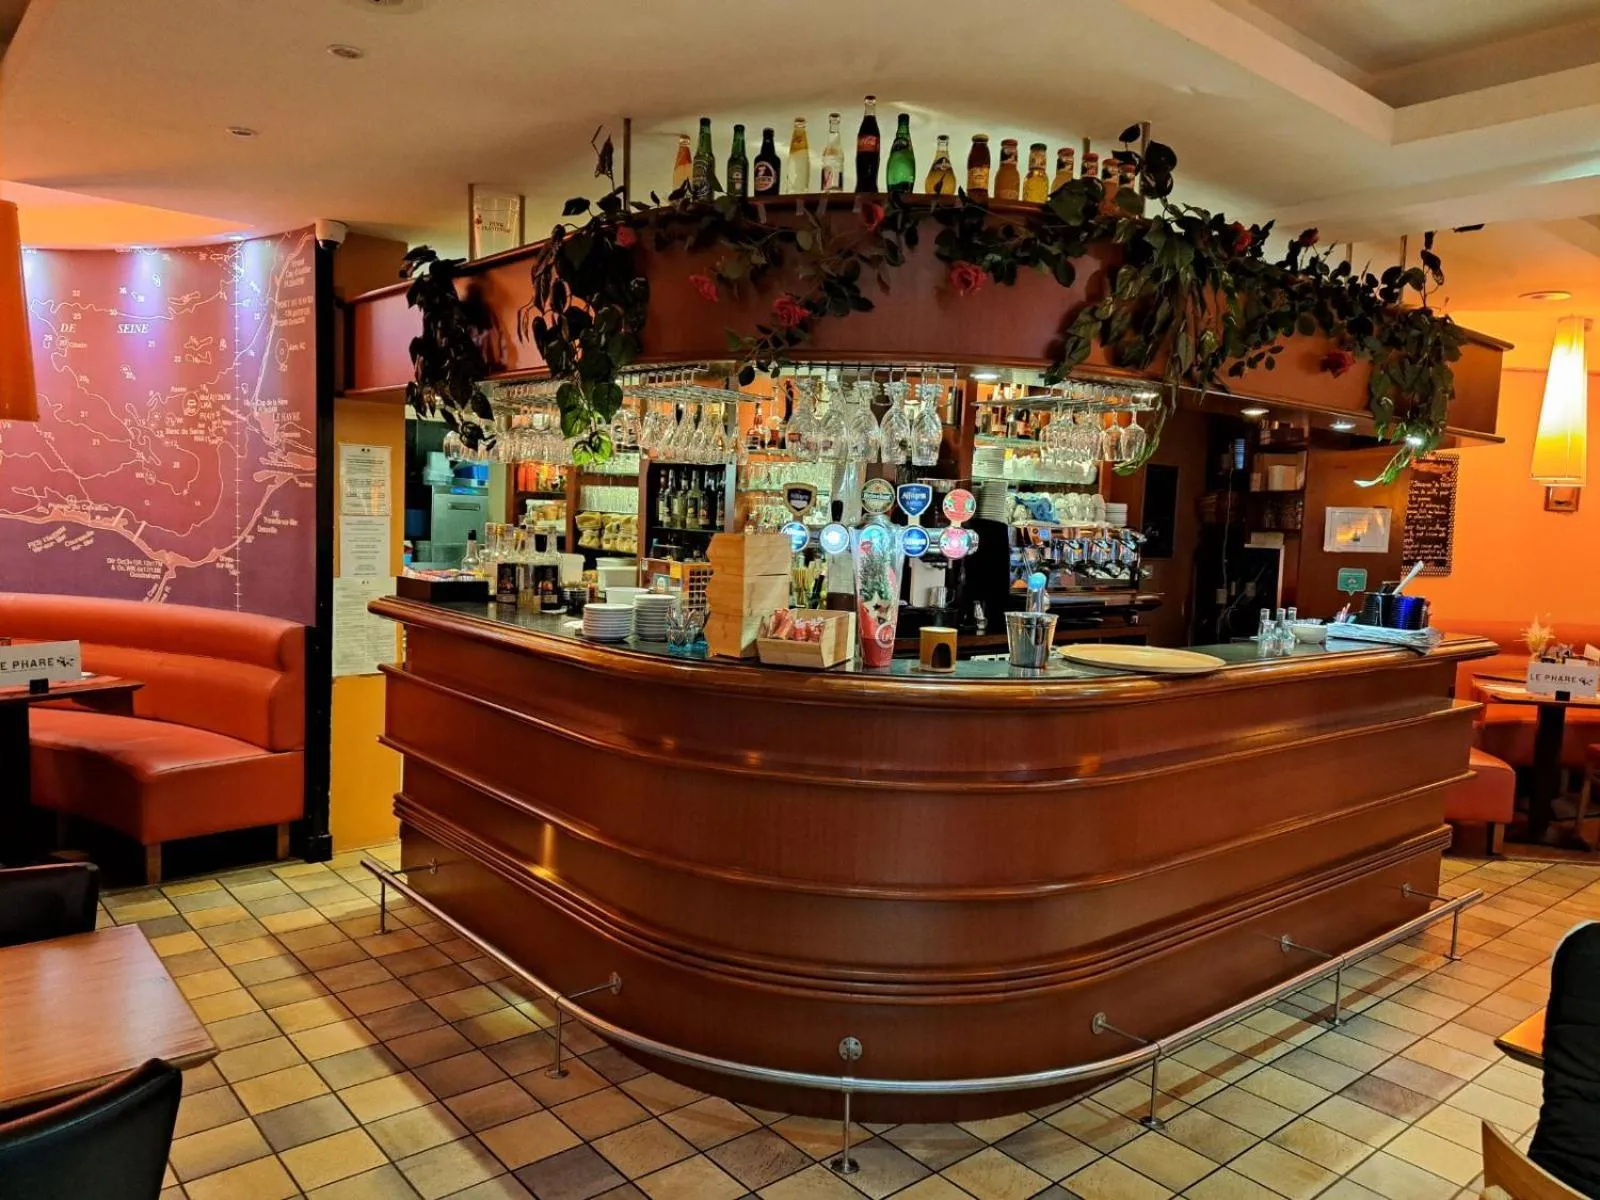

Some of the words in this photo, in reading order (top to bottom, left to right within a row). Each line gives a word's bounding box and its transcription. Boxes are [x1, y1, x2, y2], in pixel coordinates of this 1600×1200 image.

[60, 323, 77, 333] DE
[117, 323, 150, 333] SEINE
[0, 662, 7, 671] E
[12, 657, 55, 670] PHARE
[1530, 673, 1541, 682] LE
[1544, 674, 1578, 683] PHARE
